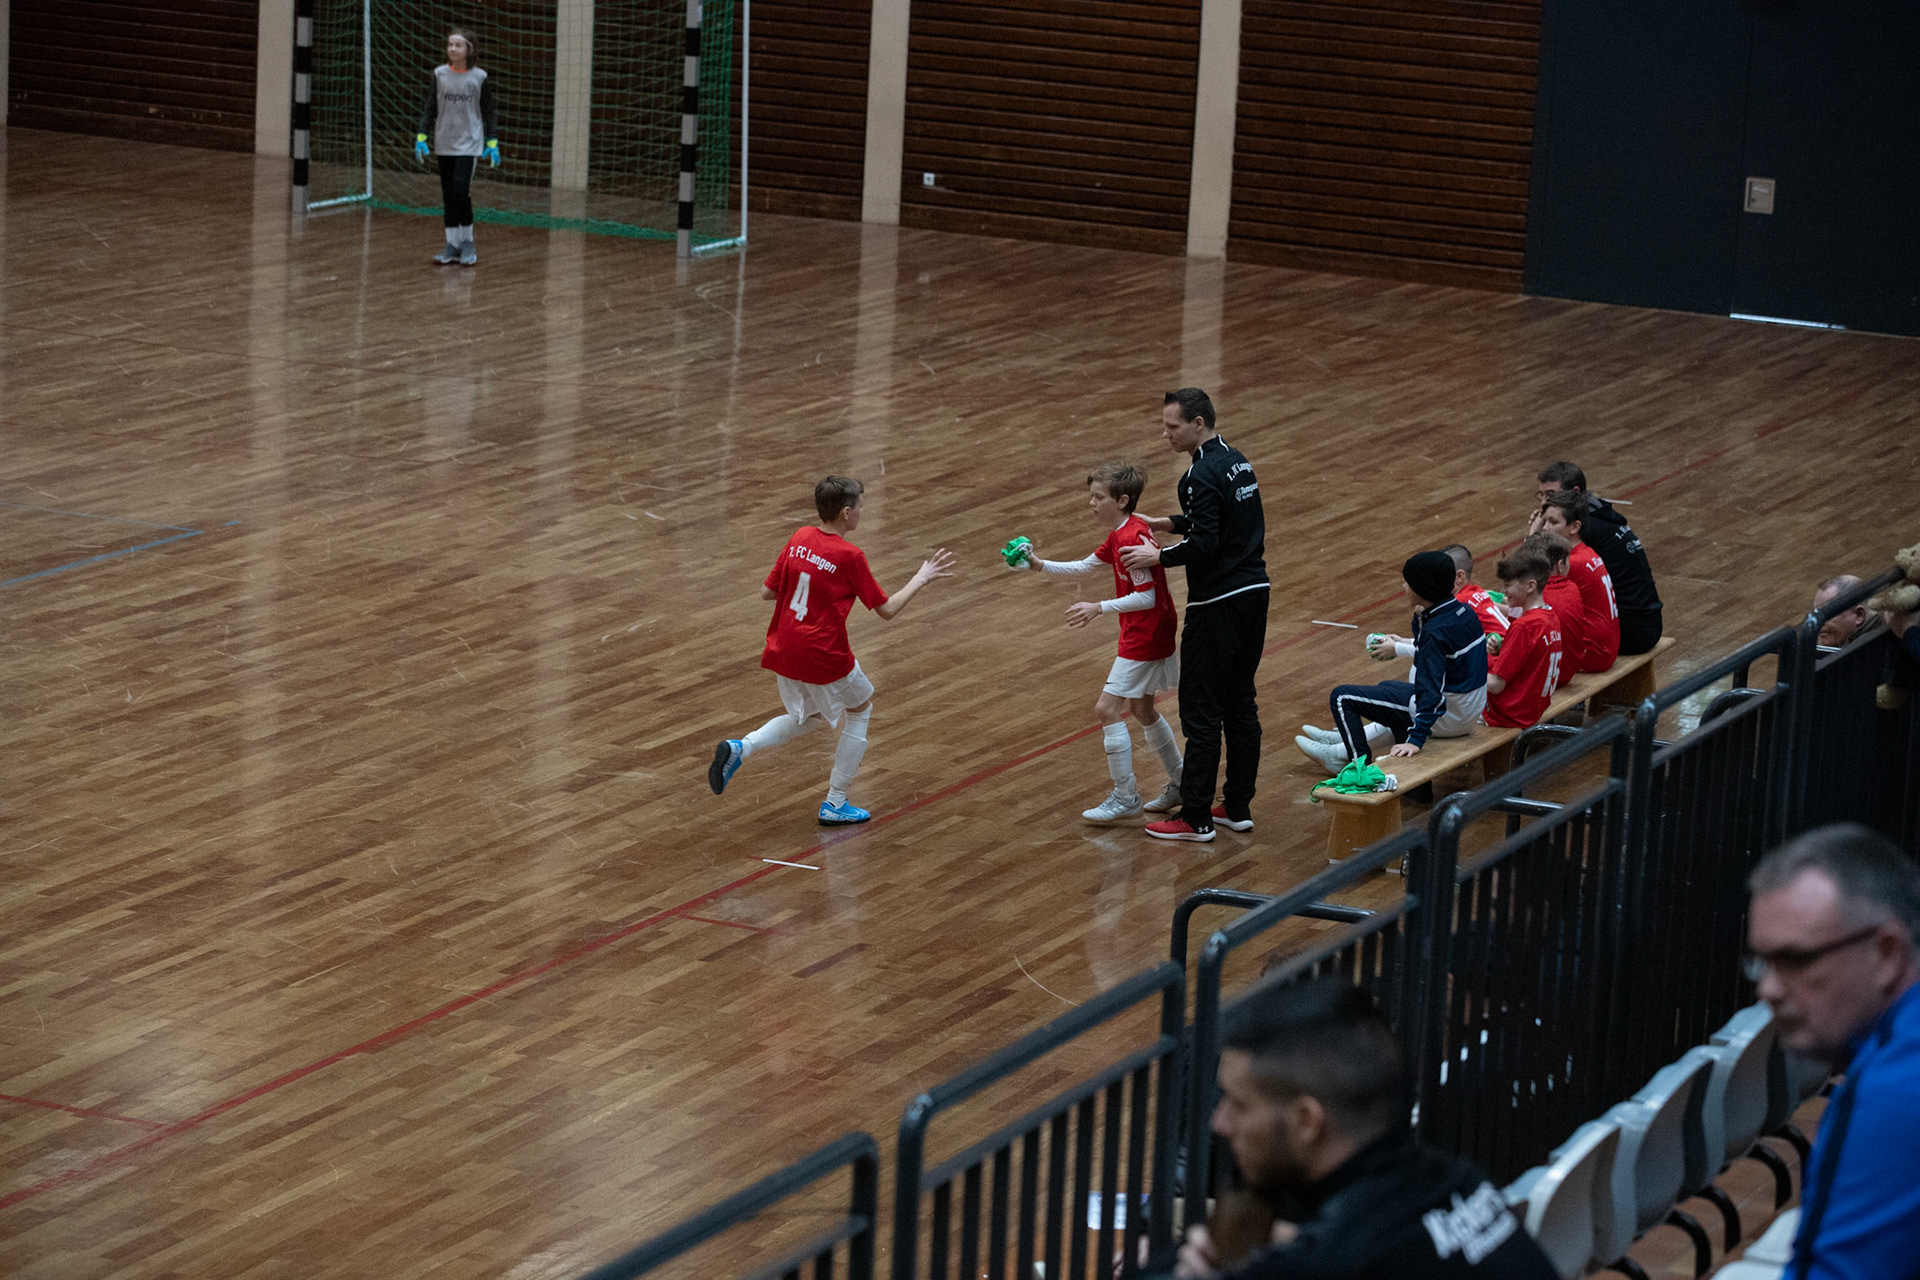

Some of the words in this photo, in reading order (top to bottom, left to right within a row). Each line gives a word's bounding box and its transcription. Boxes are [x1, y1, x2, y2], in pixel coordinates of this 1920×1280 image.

[1226, 472, 1235, 481] 1.
[788, 546, 795, 558] 1.
[796, 545, 807, 559] FC
[806, 549, 836, 574] Langen
[789, 572, 810, 621] 4
[1467, 599, 1479, 608] 1.
[1541, 651, 1562, 697] 15
